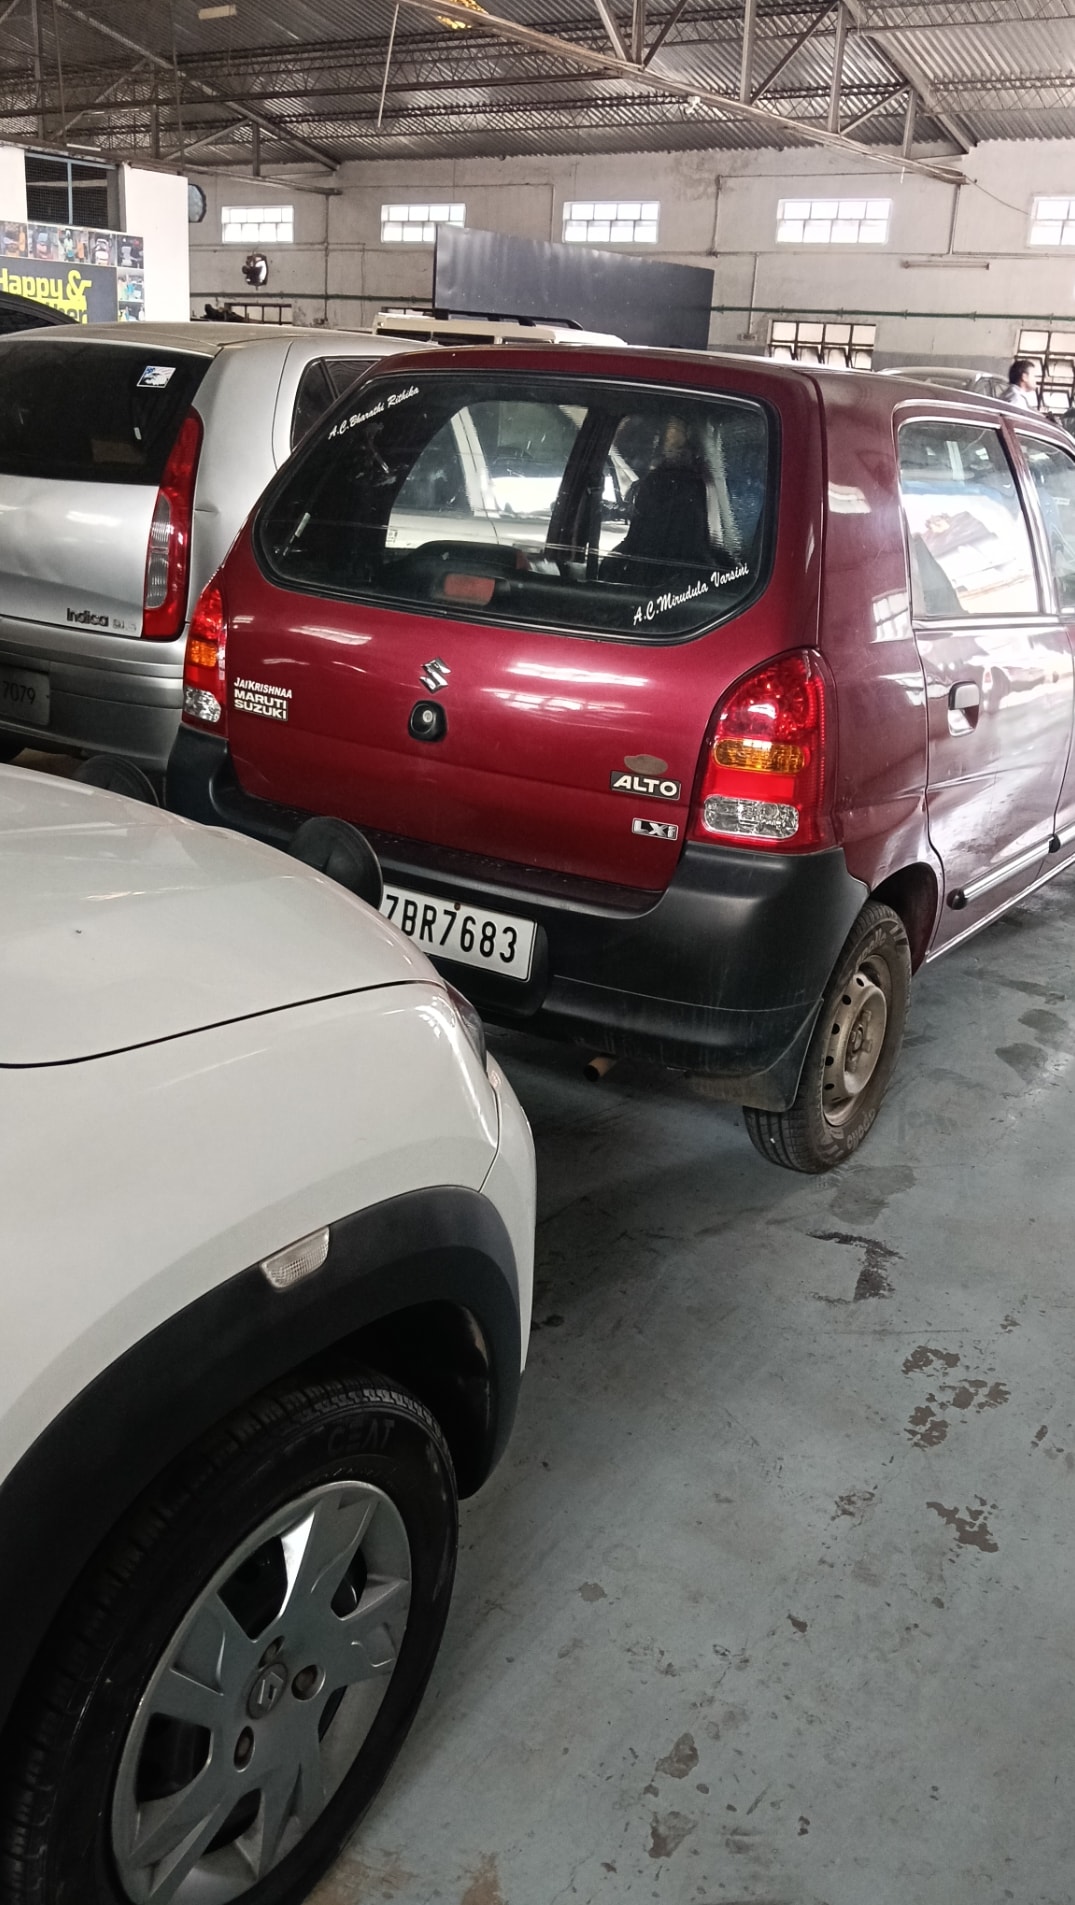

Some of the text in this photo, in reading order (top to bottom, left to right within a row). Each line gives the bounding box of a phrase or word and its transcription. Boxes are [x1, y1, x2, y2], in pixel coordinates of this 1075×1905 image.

[710, 562, 749, 588] Varsini
[66, 607, 109, 627] Indica
[2, 681, 36, 704] 7079
[233, 677, 293, 698] JAIKRISHNAA
[234, 689, 287, 709] MARUTI
[234, 699, 287, 719] SUZUKI
[612, 774, 678, 797] ALTO
[327, 1418, 396, 1455] CEAT
